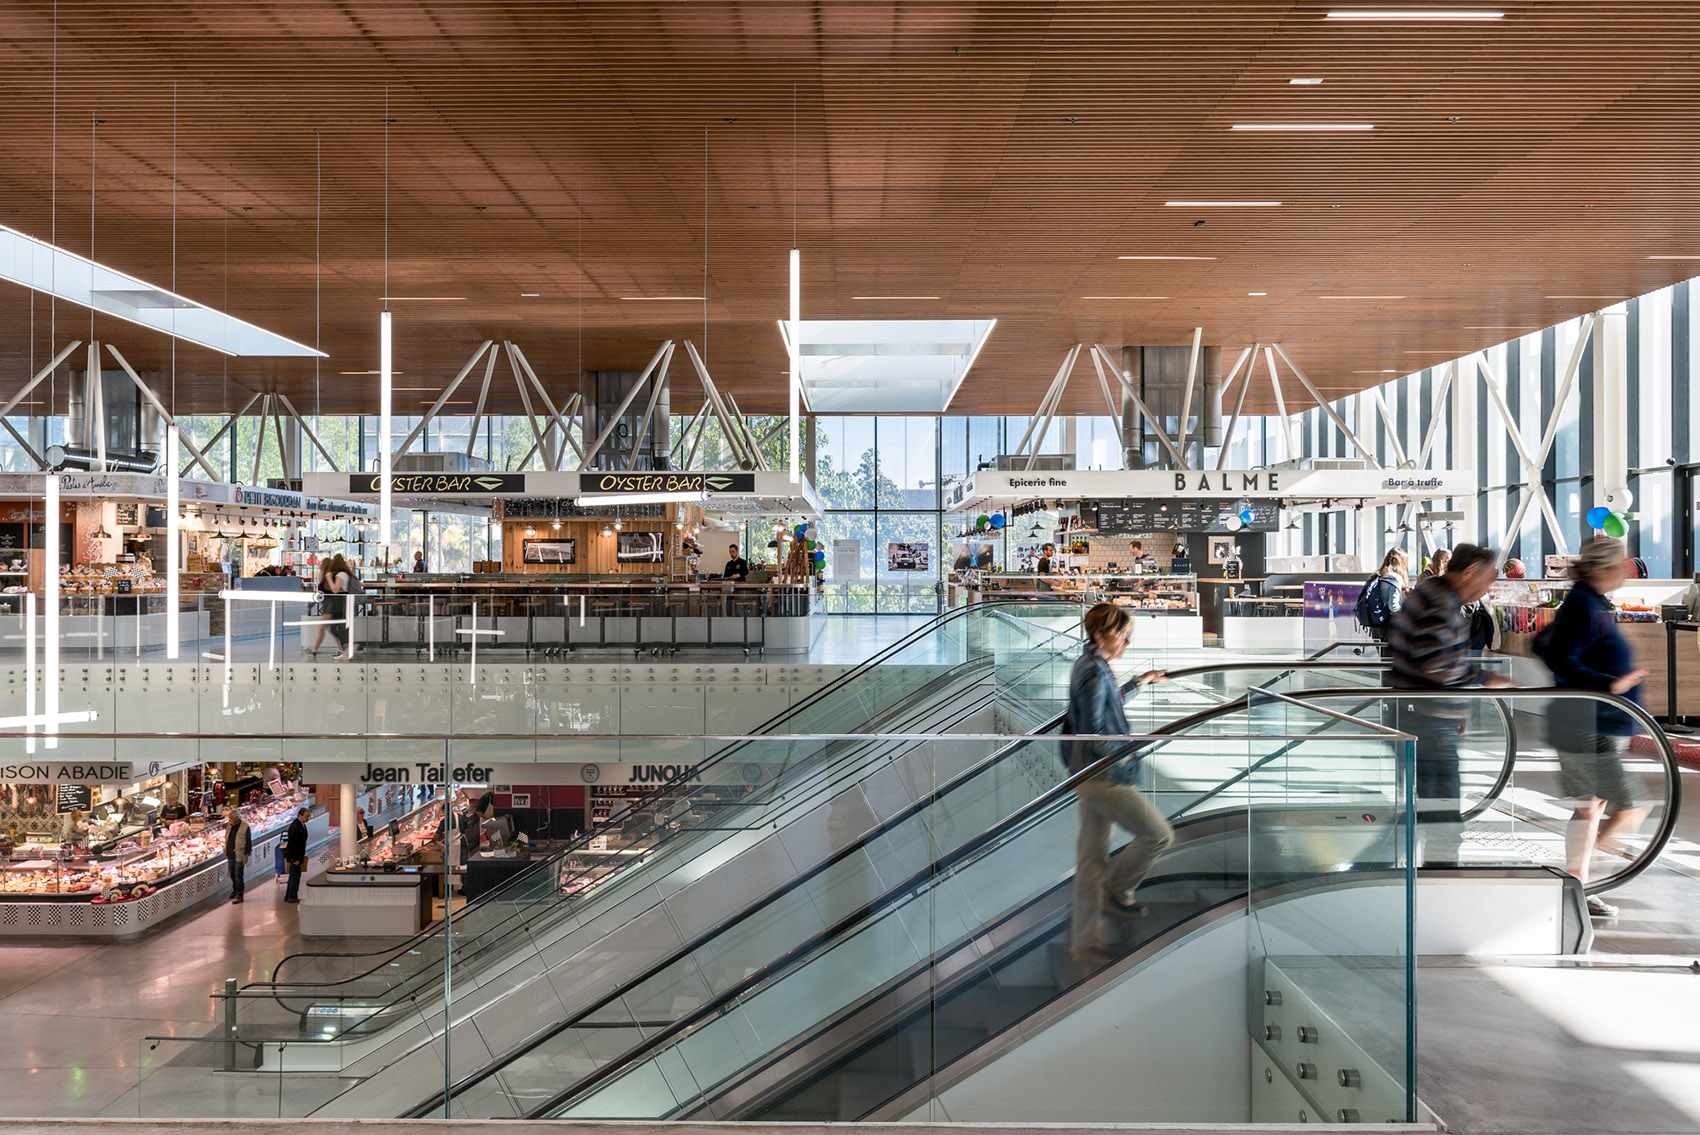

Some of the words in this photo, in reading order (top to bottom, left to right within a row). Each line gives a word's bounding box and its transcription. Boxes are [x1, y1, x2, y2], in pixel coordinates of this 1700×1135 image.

[370, 475, 433, 491] OSTER
[435, 475, 471, 491] BAR
[600, 474, 663, 491] OYSTER
[666, 475, 702, 491] BAR
[1009, 478, 1047, 489] Epicerie
[1049, 477, 1067, 487] fine
[1174, 473, 1279, 491] BALME
[1388, 477, 1405, 486] Bar
[1417, 477, 1444, 487] truffe
[57, 765, 130, 780] ABADIE
[360, 763, 410, 782] Jean
[416, 762, 494, 783] Taiefer
